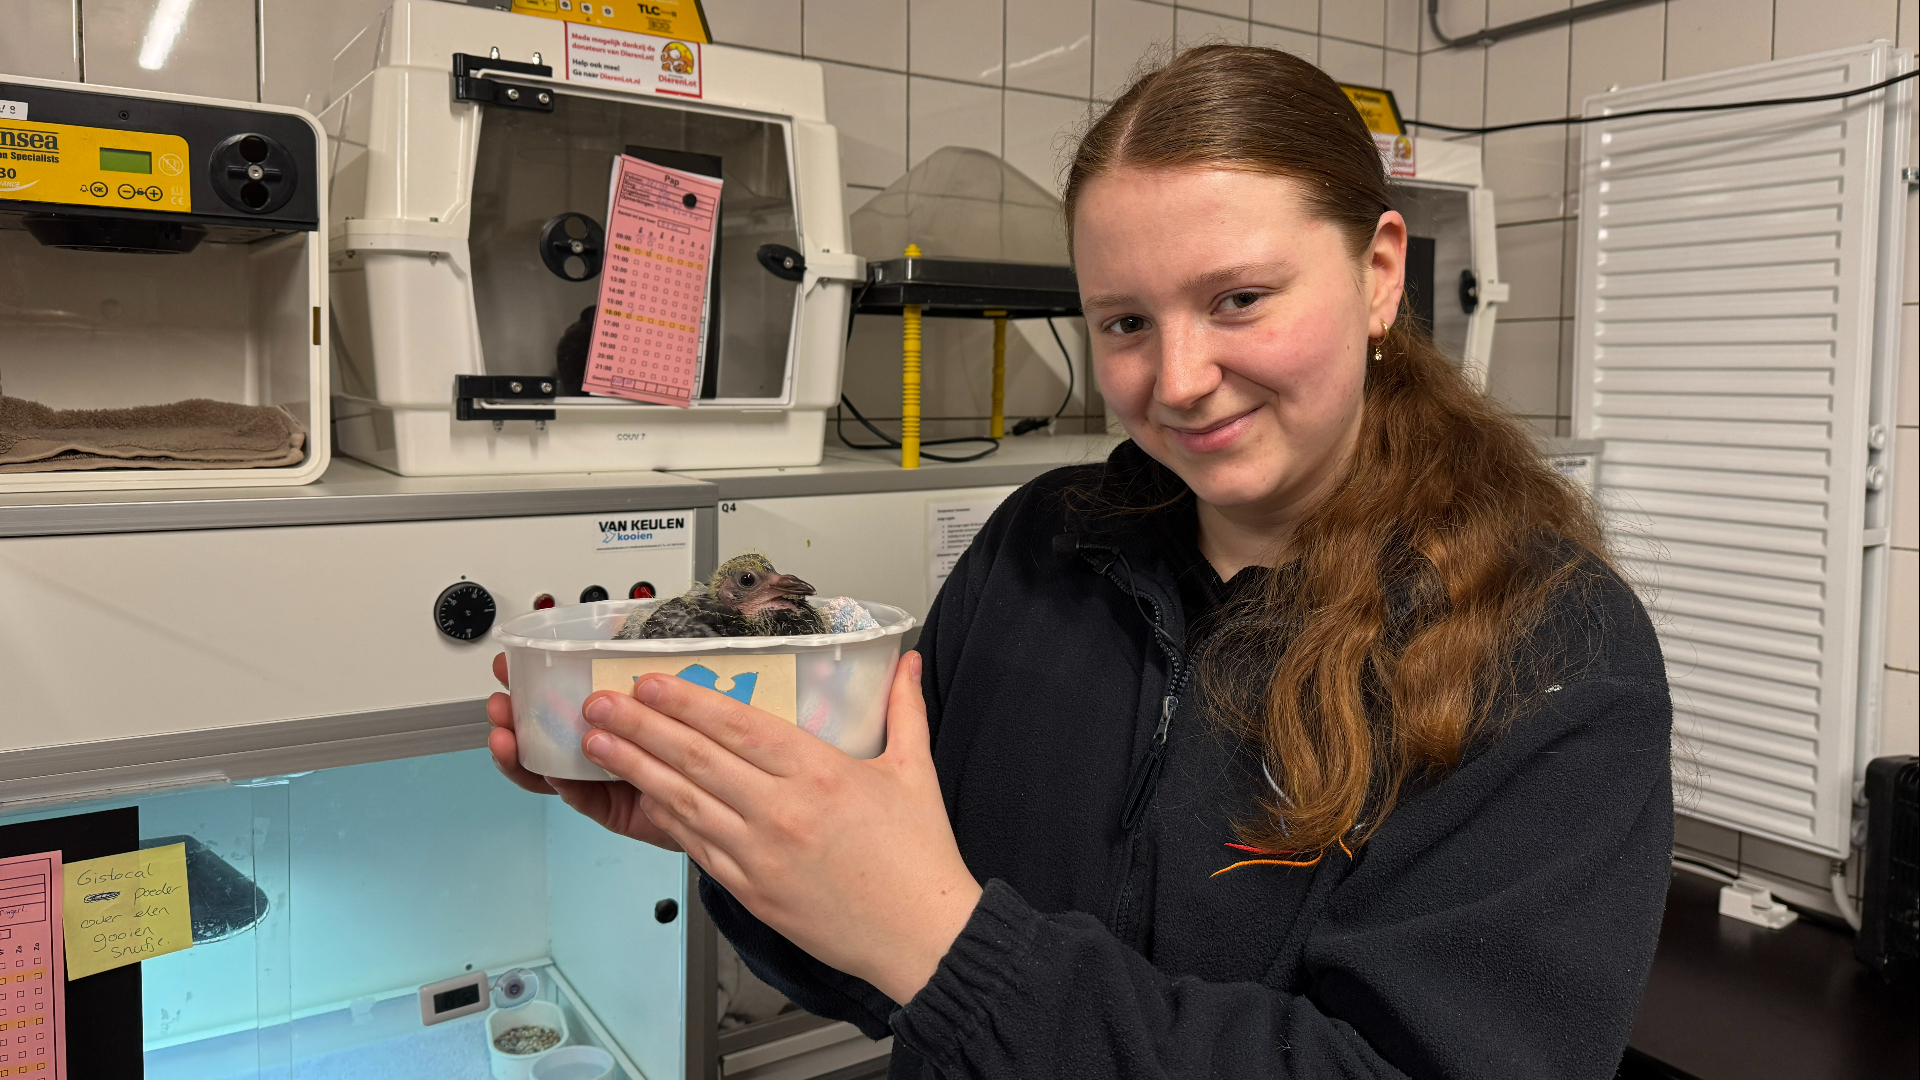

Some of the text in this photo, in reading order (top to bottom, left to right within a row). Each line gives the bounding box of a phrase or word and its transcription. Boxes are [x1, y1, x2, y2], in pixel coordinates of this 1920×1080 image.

[638, 3, 660, 16] TLC
[572, 32, 590, 41] Mede
[592, 38, 620, 46] mogelijk
[622, 41, 646, 51] dankzij
[572, 42, 606, 54] donateurs
[572, 58, 588, 68] Help
[600, 72, 641, 85] DierenLot.nl
[658, 74, 697, 88] DierenLot
[10, 152, 59, 163] Specialists
[664, 174, 680, 187] Pap
[614, 243, 630, 252] 10:00
[613, 254, 629, 263] 11:00
[612, 265, 628, 273] 12:00
[610, 276, 626, 284] 13:00
[608, 287, 625, 295] 14:00
[607, 297, 623, 306] 15:00
[605, 308, 622, 317] 16:00
[603, 319, 620, 328] 17:00
[601, 330, 618, 339] 18:00
[599, 341, 616, 350] 19:00
[597, 352, 614, 361] 20:00
[595, 363, 612, 372] 21:00
[616, 433, 640, 441] COUV
[721, 502, 737, 513] Q4
[599, 518, 684, 532] VAN KEULEN
[617, 531, 653, 541] kooien
[134, 883, 182, 905] poeder
[80, 915, 122, 929] over
[93, 926, 154, 952] gooien
